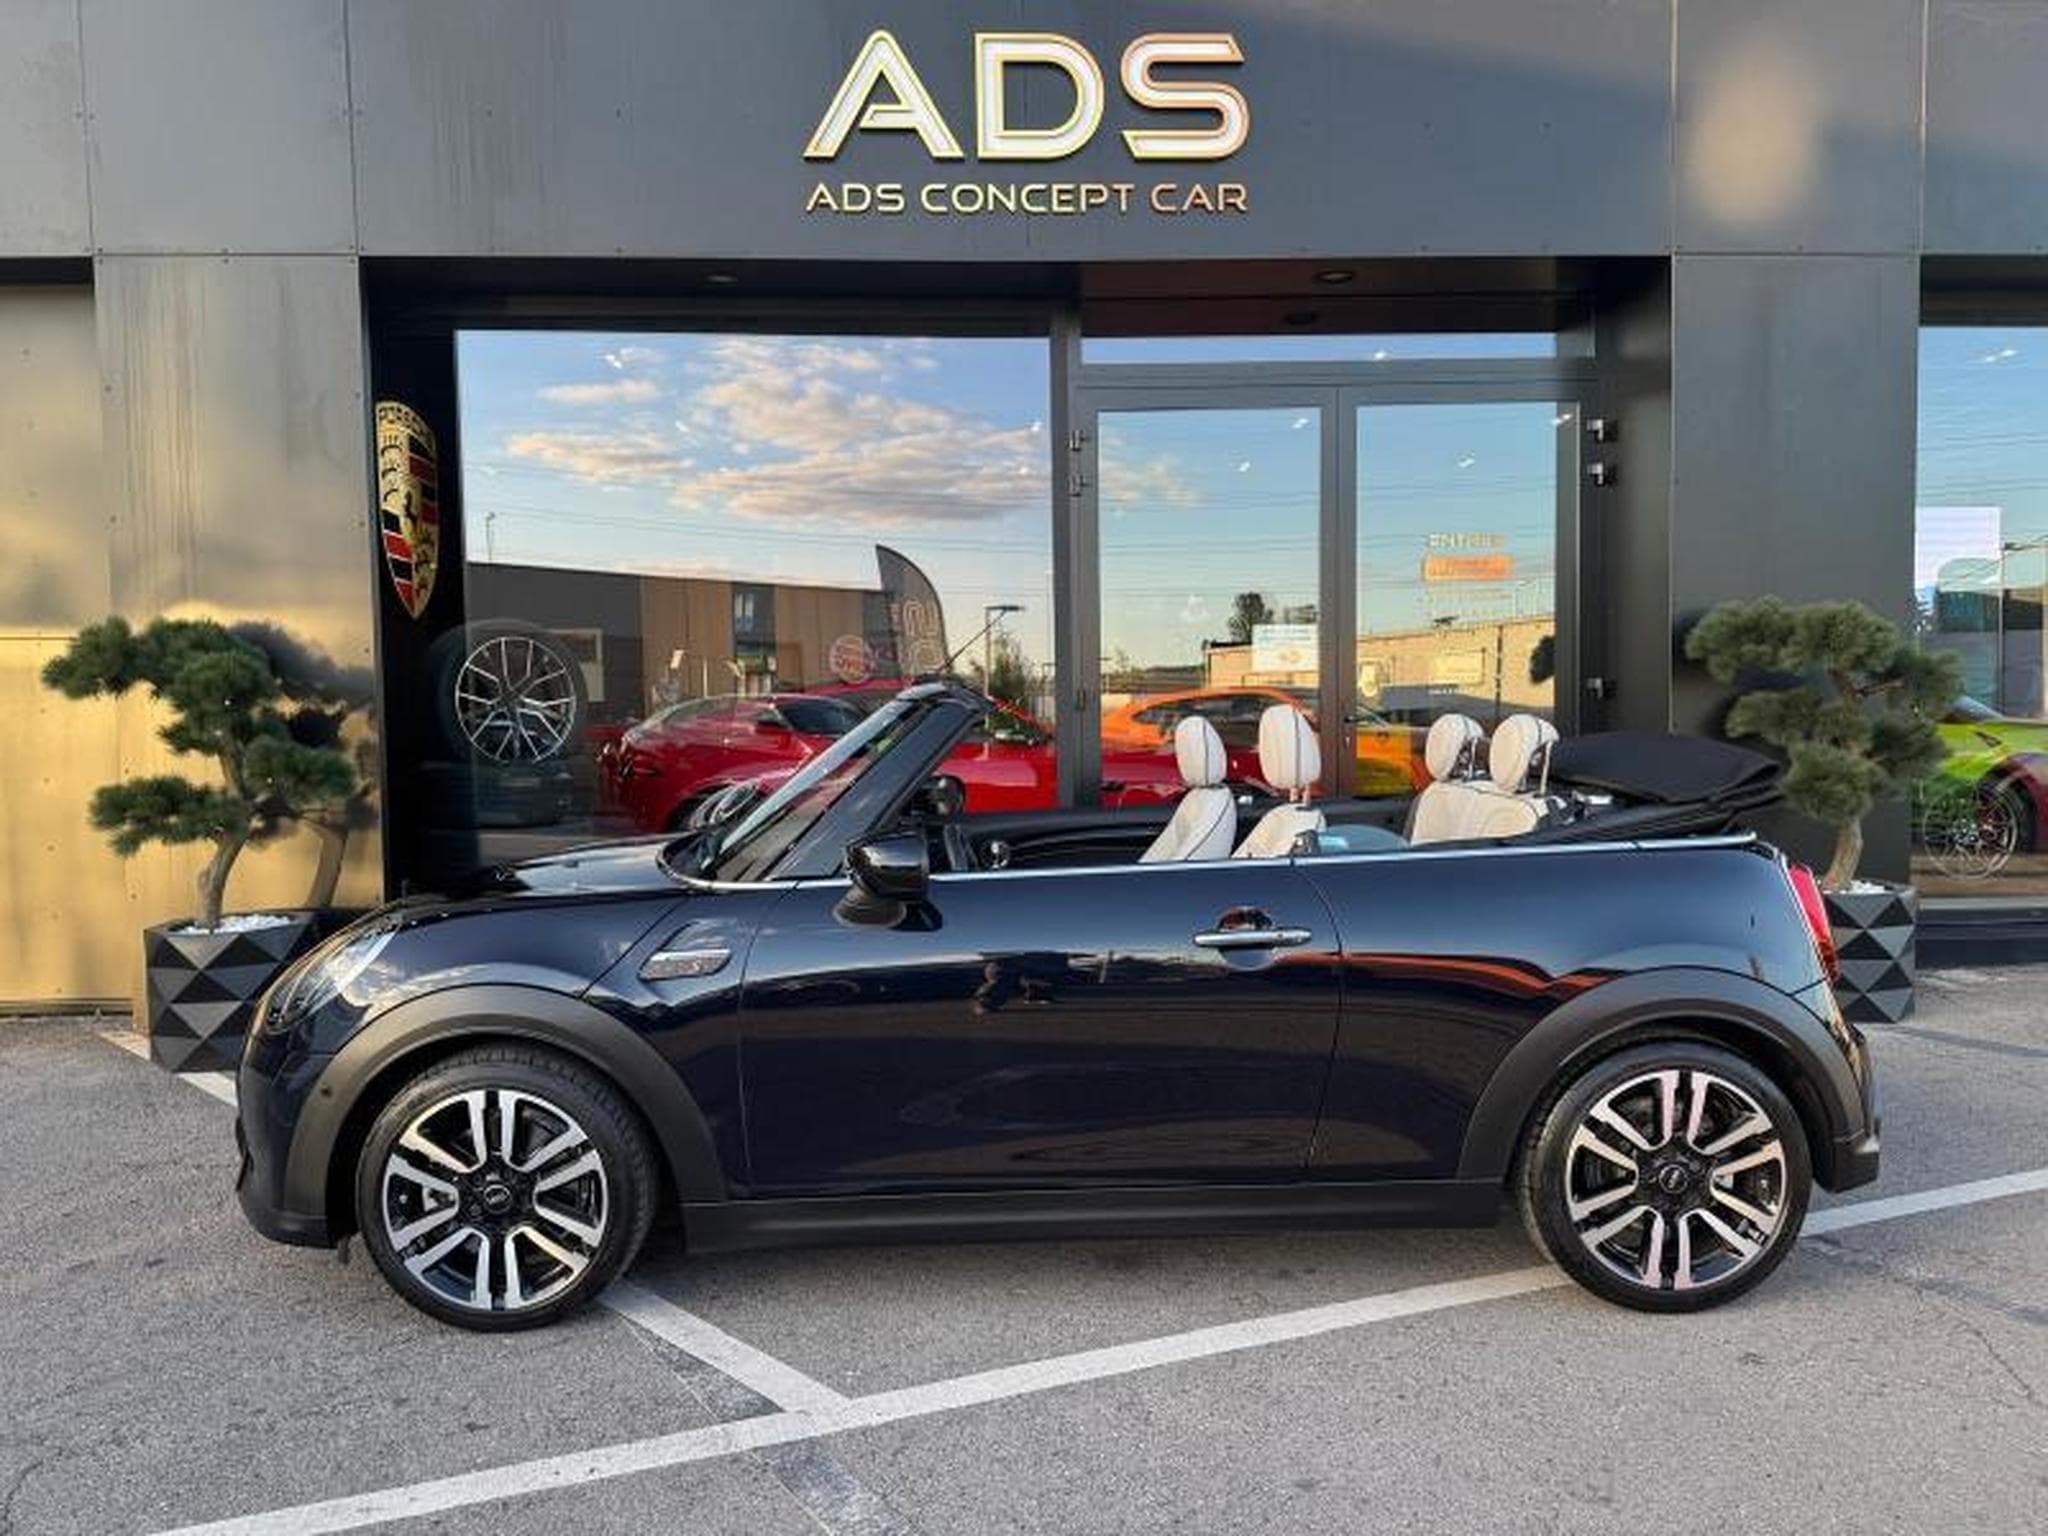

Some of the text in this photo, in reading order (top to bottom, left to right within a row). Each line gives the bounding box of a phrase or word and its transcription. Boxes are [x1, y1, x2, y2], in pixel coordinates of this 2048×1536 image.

[803, 29, 1250, 160] ADS
[805, 183, 1248, 213] ADS CONCEPT CAR
